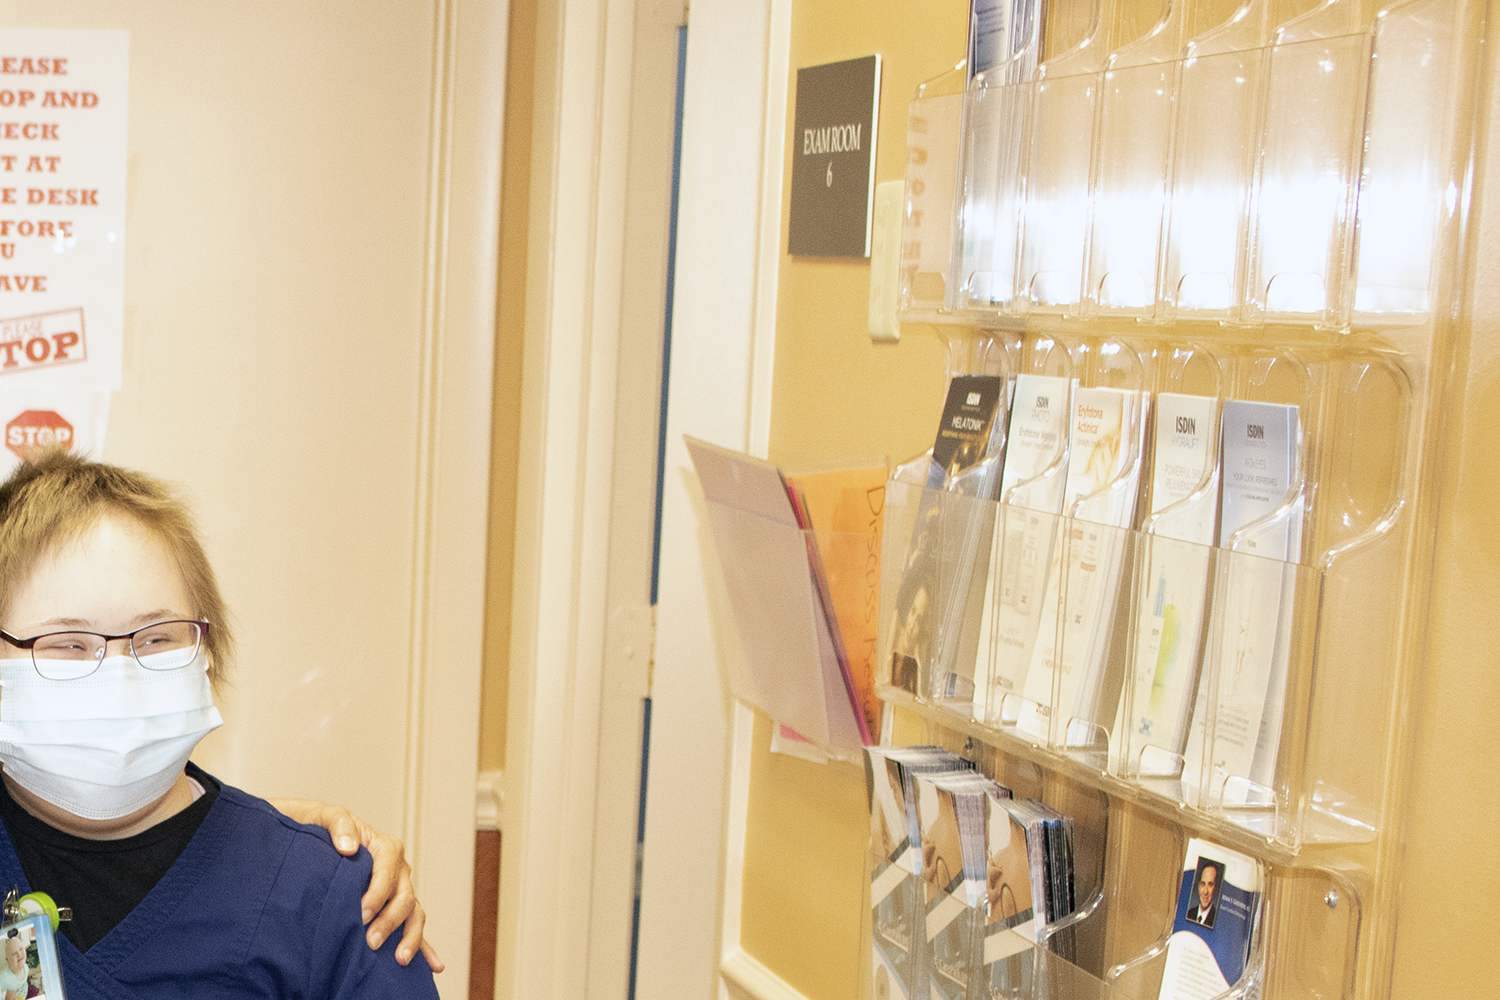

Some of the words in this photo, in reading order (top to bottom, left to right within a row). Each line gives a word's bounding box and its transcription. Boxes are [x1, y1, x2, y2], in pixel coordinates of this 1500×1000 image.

[41, 90, 99, 109] AND
[803, 127, 830, 155] EXAM
[831, 123, 861, 153] ROOM
[26, 155, 61, 173] AT
[826, 161, 833, 187] 6
[27, 188, 98, 206] DESK
[1078, 404, 1103, 420] Eryfotona
[1175, 416, 1196, 435] ISDIN
[1246, 424, 1264, 440] ISDIN
[7, 426, 73, 447] STOP
[866, 486, 886, 624] Discuss
